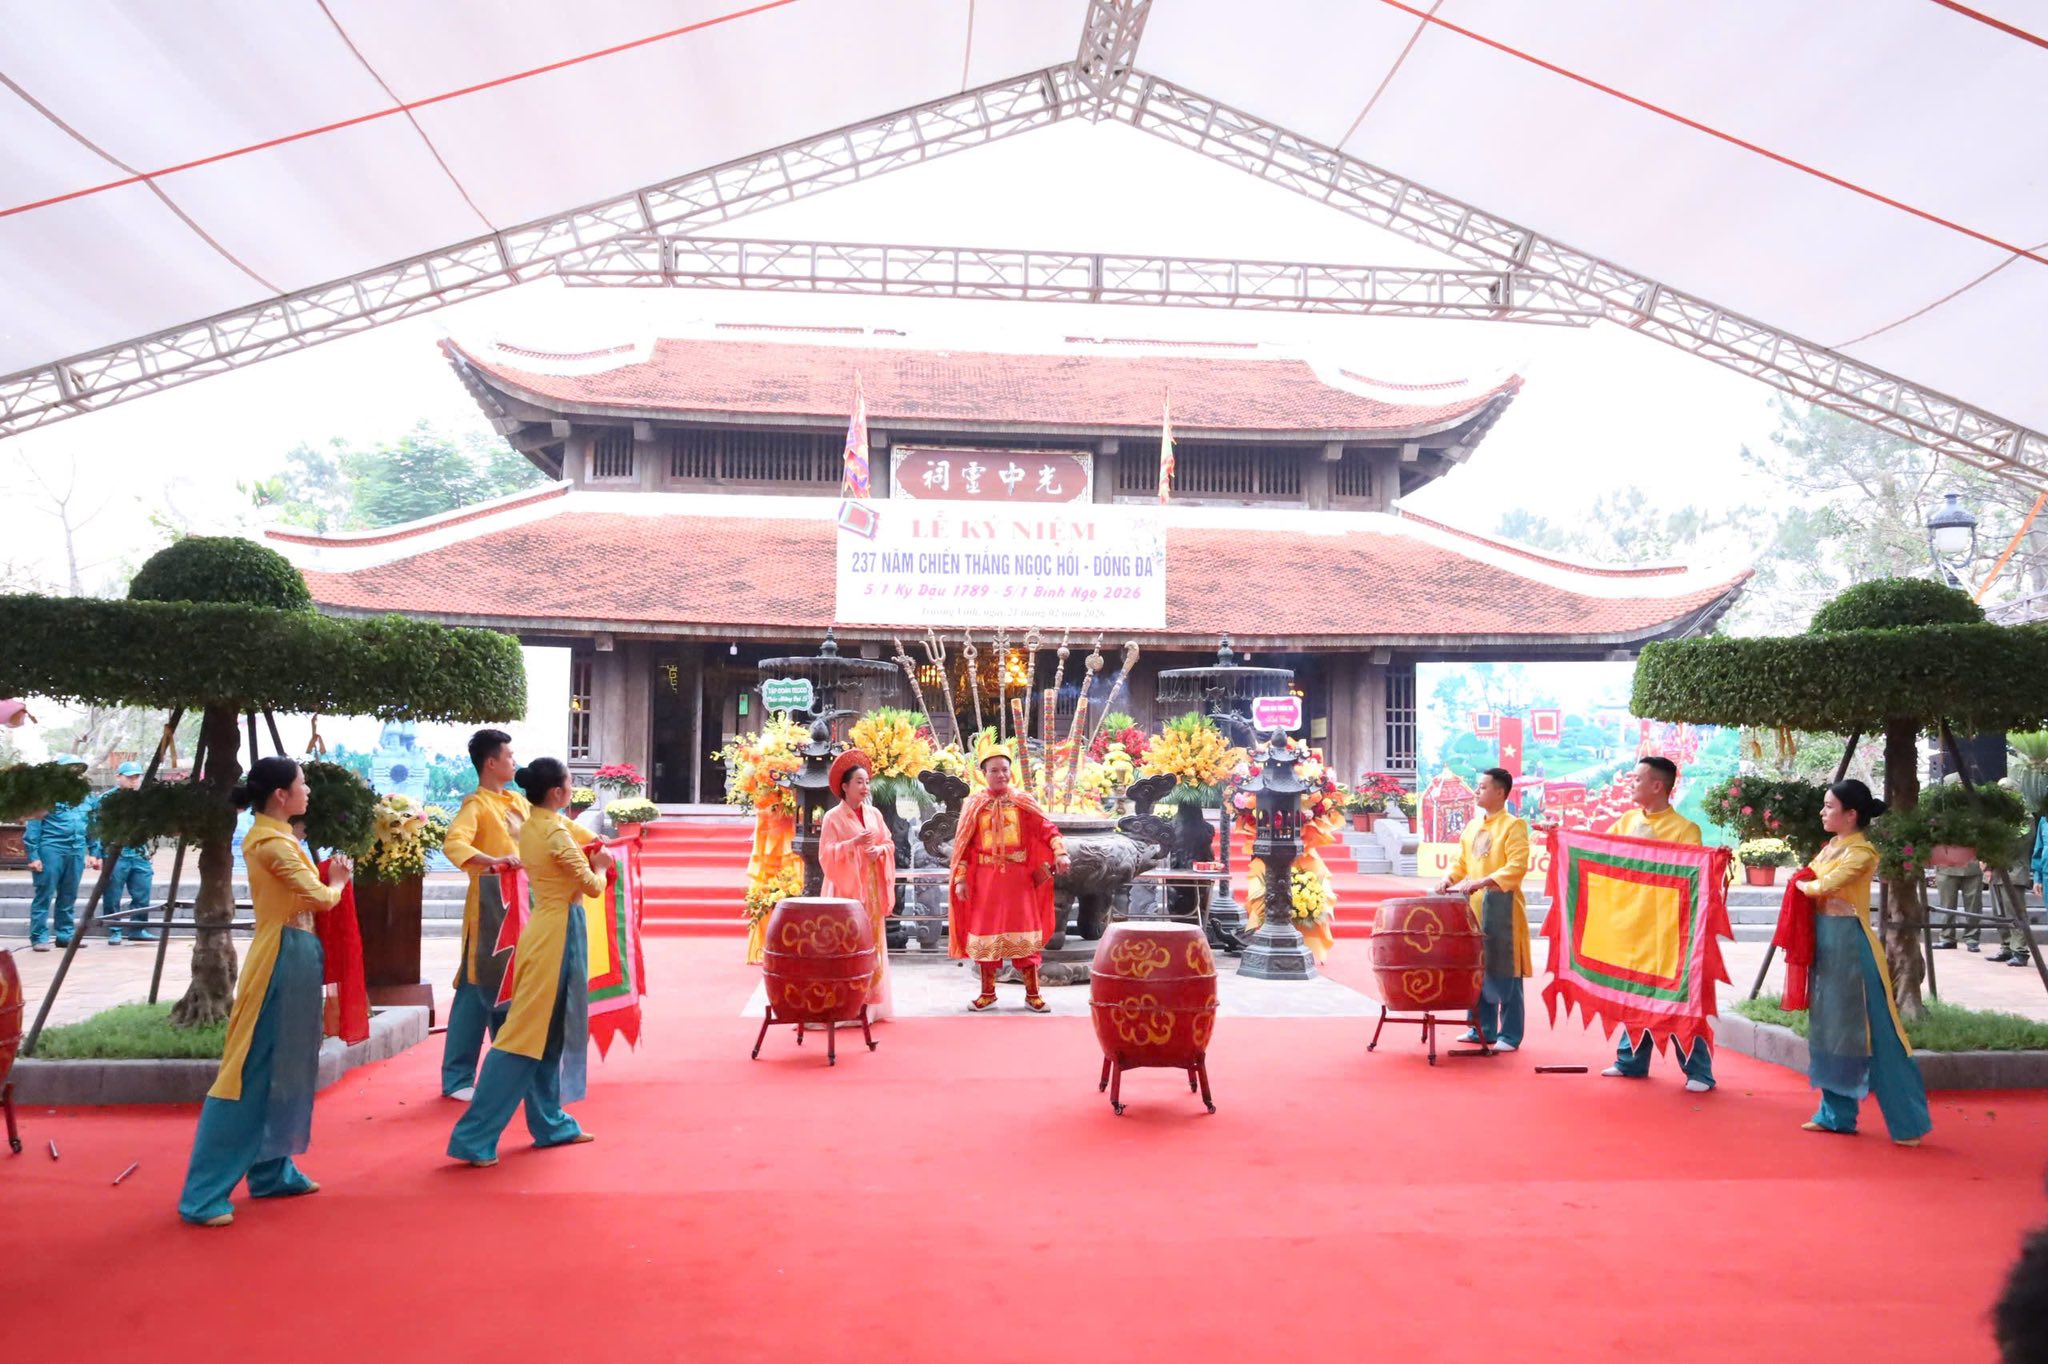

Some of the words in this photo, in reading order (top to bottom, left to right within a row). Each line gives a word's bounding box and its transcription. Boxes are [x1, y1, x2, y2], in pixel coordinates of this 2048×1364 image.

[912, 510, 949, 538] LỄ
[1012, 515, 1095, 547] NIỆM
[852, 552, 877, 573] 237
[882, 547, 914, 574] NĂM
[919, 546, 960, 575] CHIẾN
[965, 545, 1010, 576] THẮNG
[1015, 554, 1052, 581] NGỌC
[1093, 547, 1131, 577] ĐỐNG
[1135, 556, 1153, 577] ĐA
[953, 584, 990, 597] 1789
[1003, 585, 1028, 599] 5/1
[1071, 586, 1098, 602] Ngọ
[1104, 586, 1142, 600] 2026
